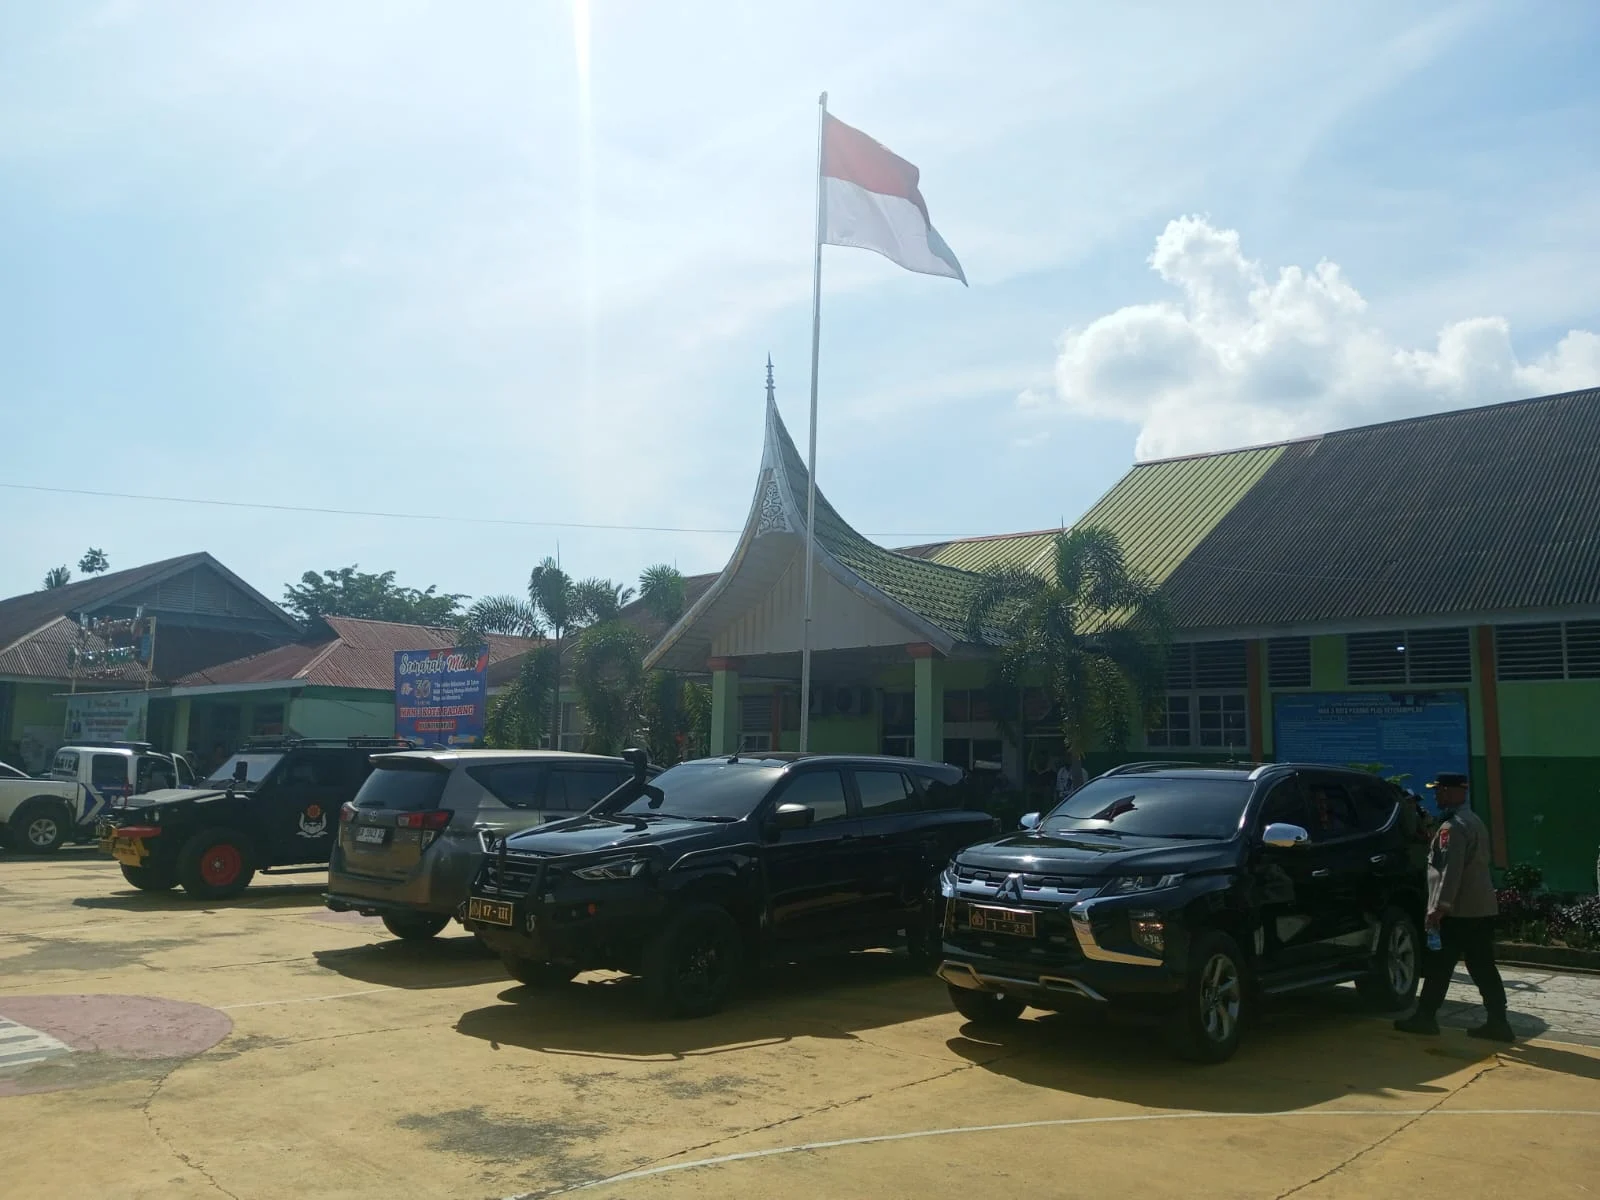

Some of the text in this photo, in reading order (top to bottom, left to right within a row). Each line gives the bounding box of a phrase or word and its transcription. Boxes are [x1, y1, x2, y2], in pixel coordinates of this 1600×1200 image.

[400, 707, 417, 717] MAN
[422, 706, 441, 717] KOTA
[442, 704, 473, 716] PADANG
